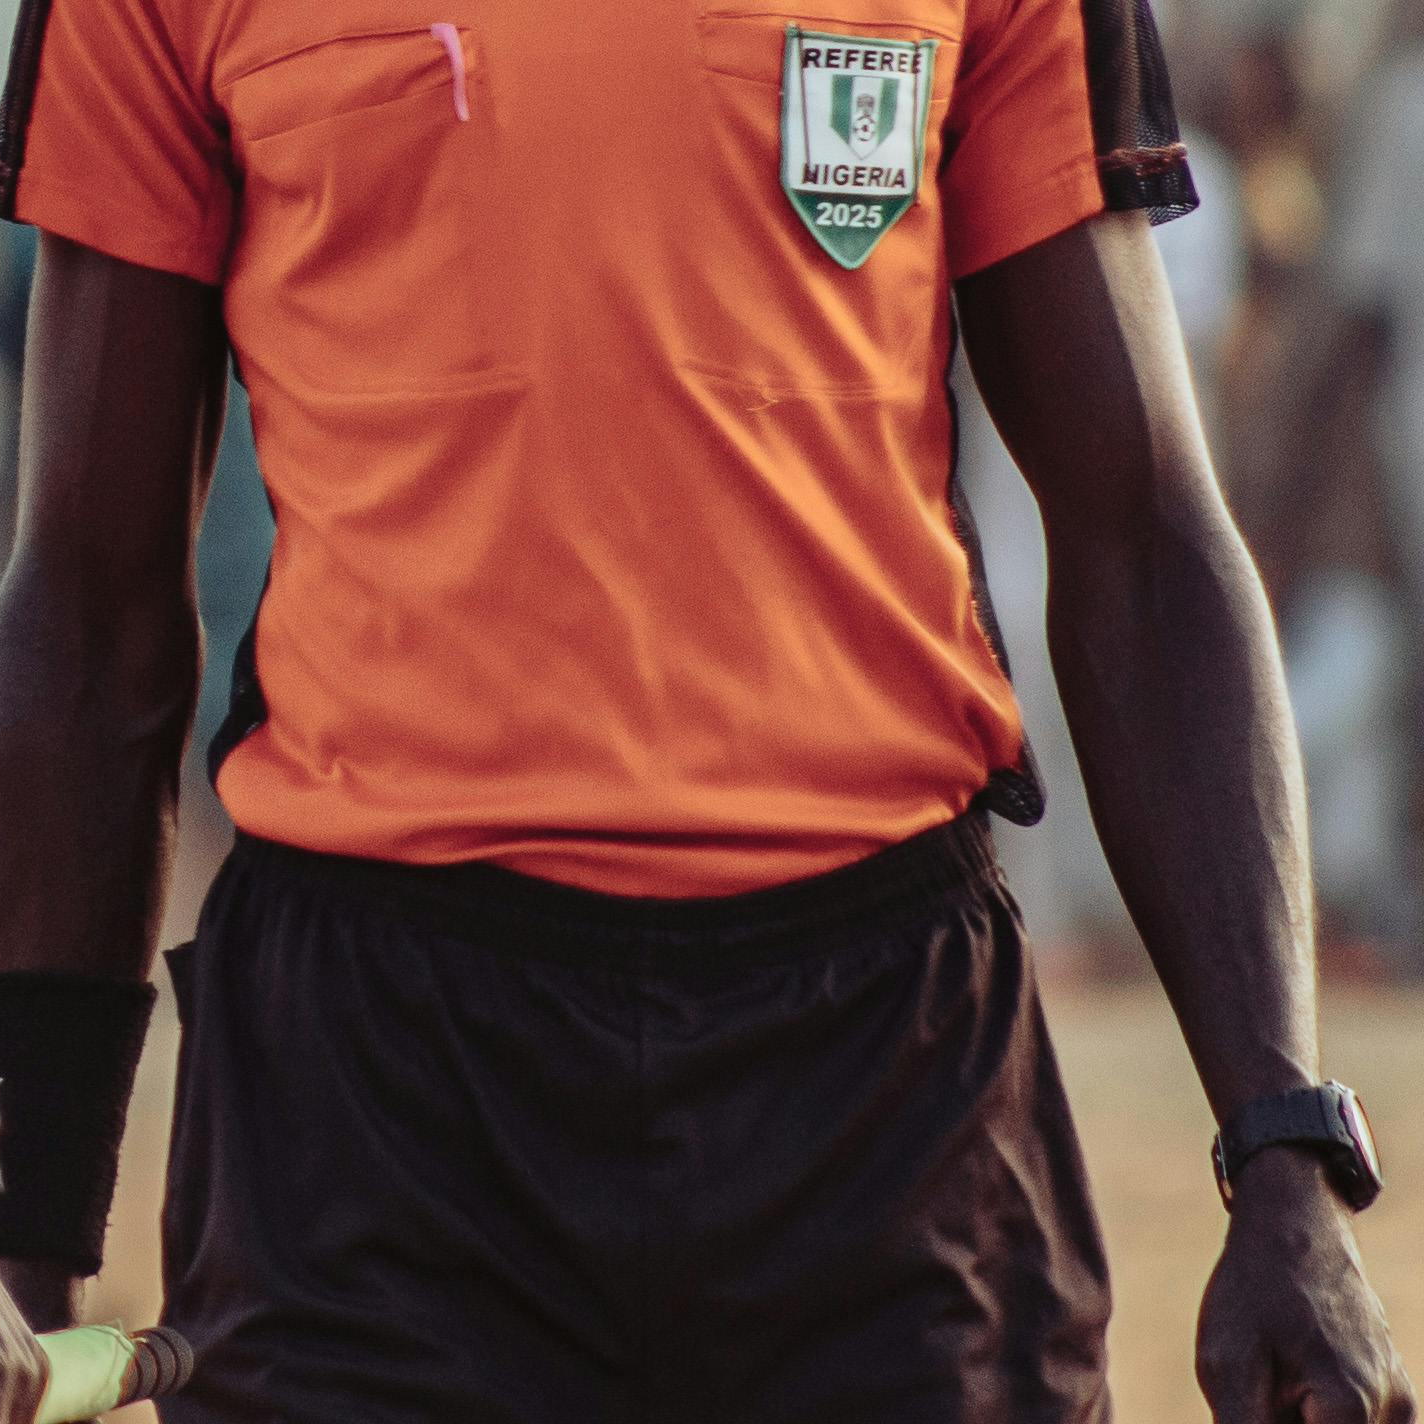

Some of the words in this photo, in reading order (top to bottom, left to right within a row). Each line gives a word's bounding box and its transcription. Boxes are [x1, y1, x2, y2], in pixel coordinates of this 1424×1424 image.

[802, 47, 921, 74] REFEREE
[801, 162, 907, 188] NIGERIA
[815, 202, 883, 228] 2025
